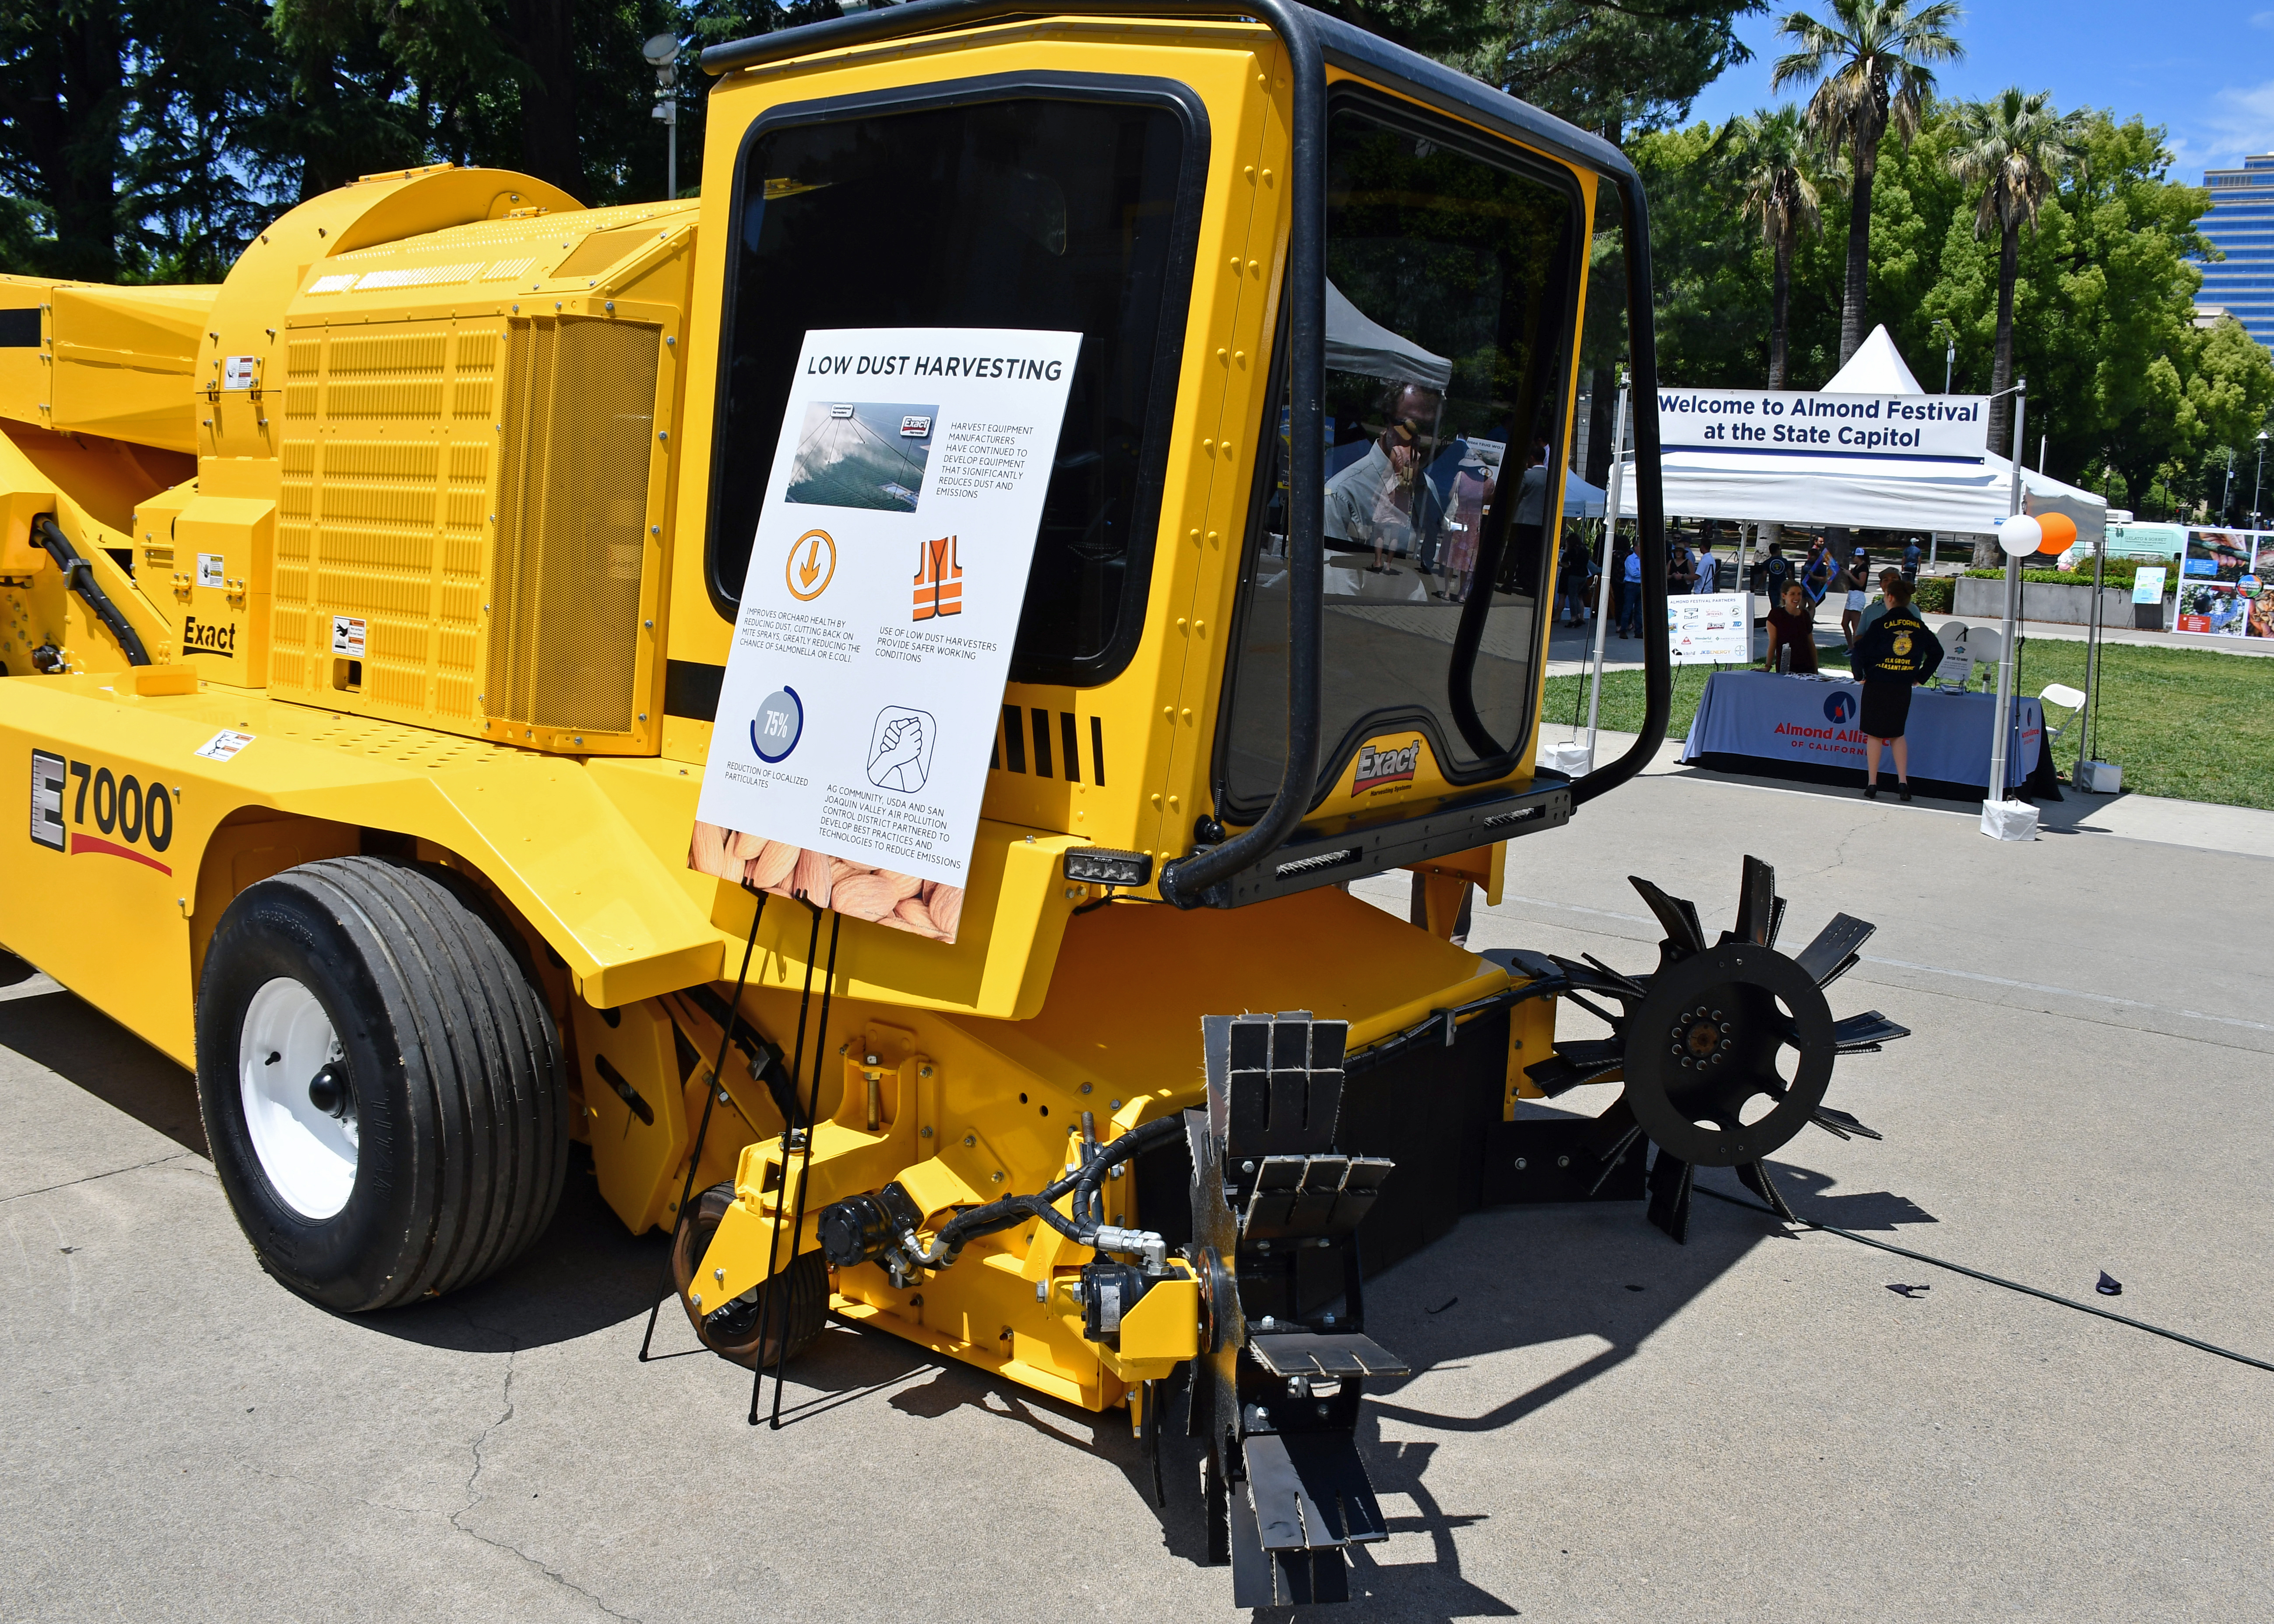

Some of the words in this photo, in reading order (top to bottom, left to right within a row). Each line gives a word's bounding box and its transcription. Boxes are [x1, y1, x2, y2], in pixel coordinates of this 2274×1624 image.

[808, 356, 853, 374] LOW
[856, 356, 910, 375] DUST
[914, 356, 1062, 381] HARVESTING
[1658, 396, 1755, 415] Welcome
[1762, 398, 1784, 415] to
[1790, 398, 1880, 418] Almond
[1887, 400, 1978, 421] Festival
[905, 418, 929, 428] Exact
[951, 422, 986, 431] HARVEST
[988, 424, 1034, 435] EQUIPMENT
[948, 433, 1015, 444] MANUFACTURERS
[1704, 424, 1726, 439] at
[1732, 422, 1766, 441] the
[1773, 424, 1830, 443] State
[1838, 426, 1920, 449] Capitol
[944, 455, 977, 464] DEVELOP
[979, 457, 1025, 468] EQUIPMENT
[946, 444, 967, 452] HAVE
[969, 446, 1014, 456] CONTINUED
[939, 477, 972, 486] REDUCES
[974, 479, 994, 488] DUST
[995, 482, 1013, 490] AND
[942, 466, 961, 474] THAT
[962, 467, 1023, 479] SIGNIFICANTLY
[936, 487, 978, 498] EMISSIONS
[744, 618, 774, 628] REDUCING
[775, 622, 791, 632] DUST,
[794, 625, 821, 636] CUTTING
[823, 629, 841, 639] BACK
[843, 632, 854, 640] ON
[746, 608, 777, 618] IMPROVES
[778, 612, 809, 622] ORCHARD
[810, 616, 836, 626] HEALTH
[1884, 619, 1920, 629] CALIFORNIA
[184, 616, 236, 650] Exact
[742, 628, 756, 636] MITE
[757, 630, 780, 641] SPRAYS,
[783, 634, 811, 644] GREATLY
[812, 638, 846, 650] REDUCING
[848, 644, 861, 653] THE
[880, 626, 893, 635] USE
[906, 630, 923, 640] LOW
[925, 633, 944, 643] DUST
[946, 636, 996, 651] HARVESTERS
[740, 638, 764, 648] CHANCE
[775, 643, 815, 657] SALMONELLA
[829, 652, 851, 663] E.COLI.
[876, 648, 921, 662] CONDITIONS
[877, 637, 910, 649] PROVIDE
[912, 643, 934, 653] SAFER
[938, 647, 975, 660] WORKING
[764, 710, 789, 739] 75%
[1774, 722, 1834, 740] Almond
[1355, 739, 1419, 781] Exact
[725, 772, 768, 788] PARTICULATES
[727, 761, 761, 775] REDUCTION
[772, 771, 808, 786] LOCALIZED
[31, 748, 172, 853] E7000
[827, 784, 837, 793] AG
[839, 787, 884, 805] COMMUNITY,
[887, 797, 906, 808] USDA
[908, 802, 925, 812] AND
[927, 806, 944, 817] SAN
[1370, 787, 1394, 797] Harvesting
[1394, 784, 1412, 793] Systems
[823, 806, 855, 820] CONTROL
[857, 814, 891, 828] DISTRICT
[892, 822, 936, 839] PARTNERED
[940, 833, 949, 842] TO
[825, 795, 857, 809] JOAQUIN
[860, 802, 886, 815] VALLEY
[887, 810, 901, 819] AIR
[904, 813, 947, 830] POLLUTION
[820, 816, 852, 830] DEVELOP
[853, 824, 870, 835] BEST
[872, 829, 913, 845] PRACTICES
[915, 840, 932, 850] AND
[820, 827, 872, 847] TECHNOLOGIES
[875, 841, 884, 850] TO
[886, 844, 915, 858] REDUCE
[917, 851, 961, 868] EMISSIONS
